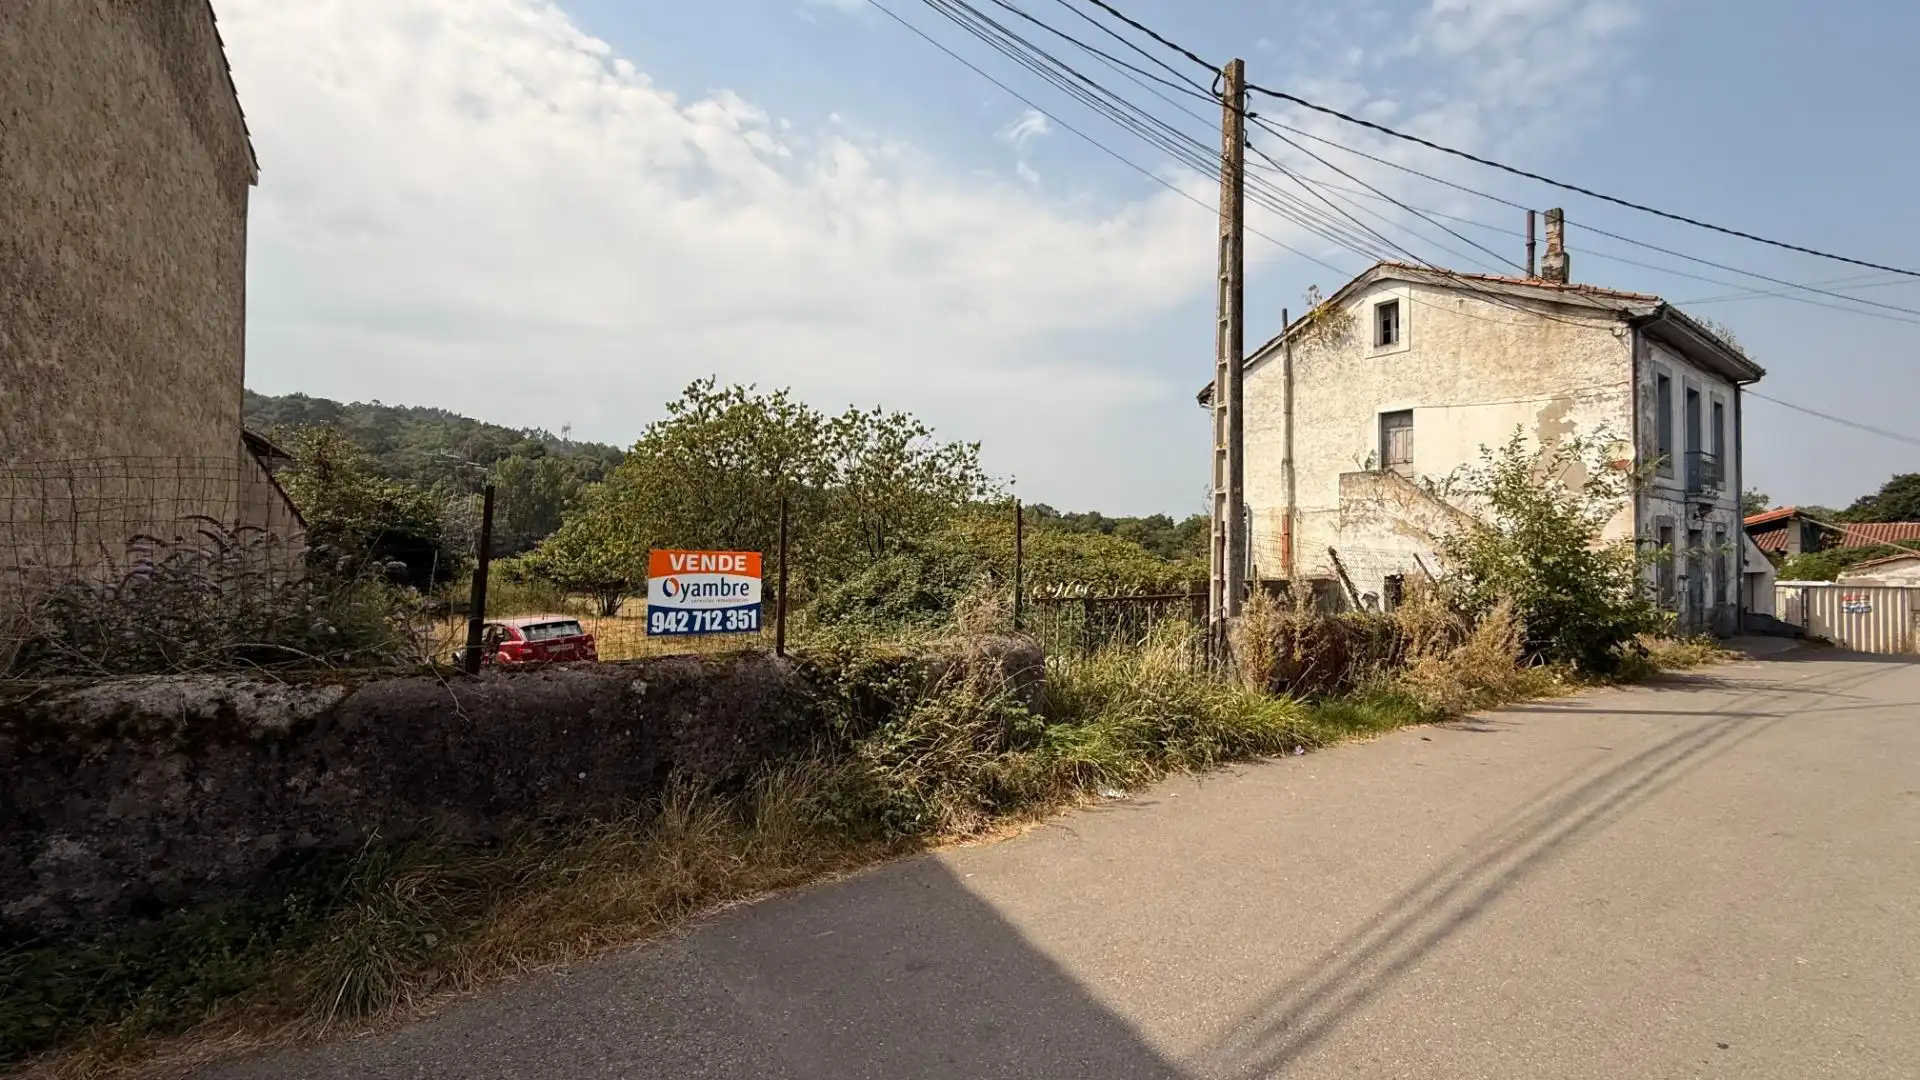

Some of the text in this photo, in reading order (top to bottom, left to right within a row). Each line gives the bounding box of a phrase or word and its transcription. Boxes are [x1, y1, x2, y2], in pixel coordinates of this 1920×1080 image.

[668, 553, 747, 571] VENDE
[662, 577, 749, 603] Oyambre
[651, 609, 756, 633] 942 712 351
